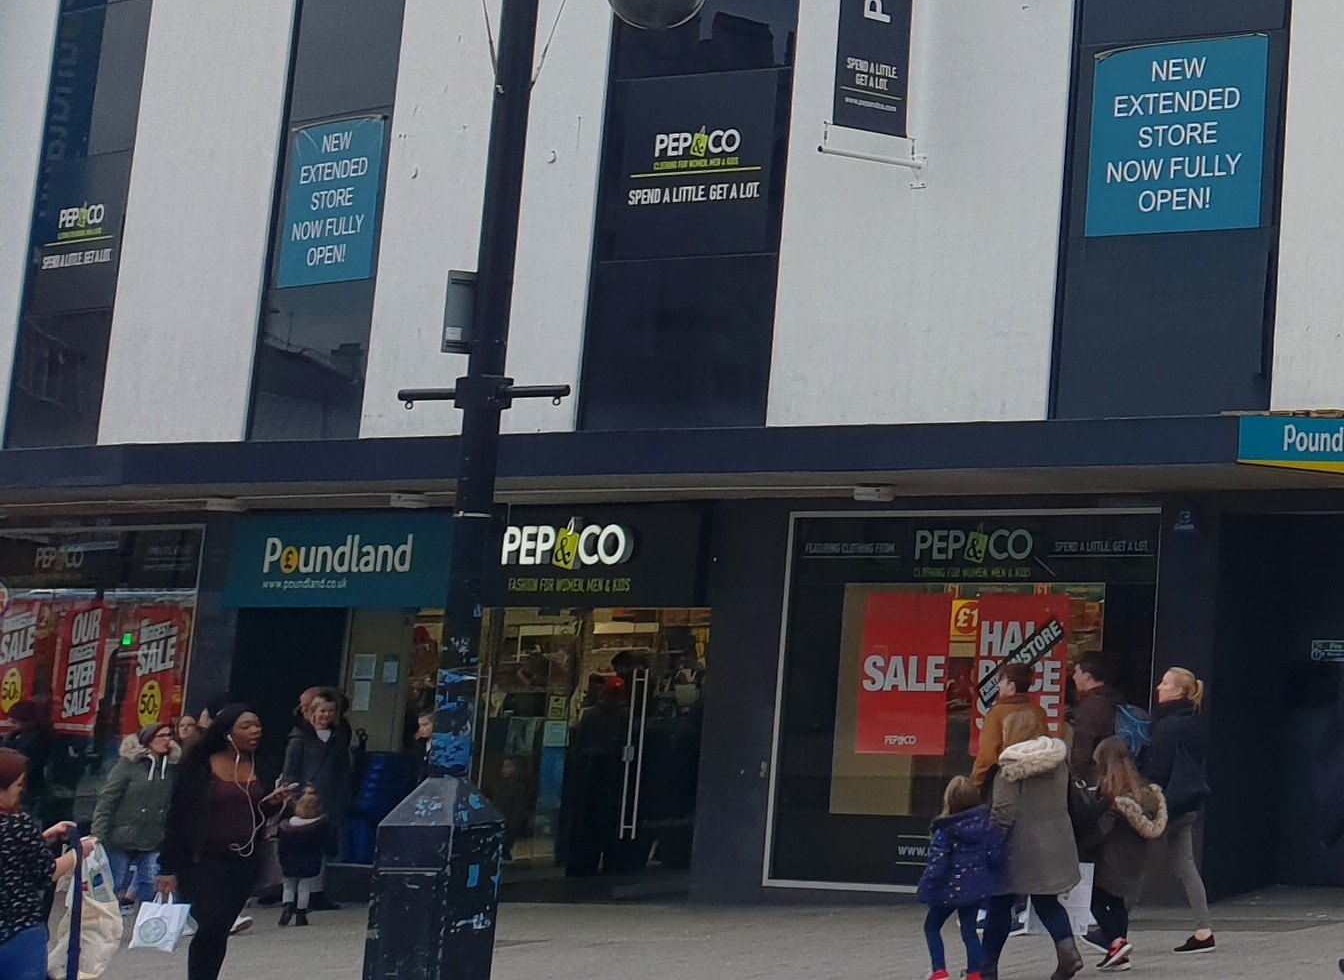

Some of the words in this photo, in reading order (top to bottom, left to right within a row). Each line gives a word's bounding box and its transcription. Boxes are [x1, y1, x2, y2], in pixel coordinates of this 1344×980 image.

[847, 57, 868, 72] SPEND
[1151, 56, 1207, 82] NEW
[855, 73, 868, 86] GET
[1113, 87, 1240, 117] EXTENDED
[322, 131, 352, 153] NEW
[654, 127, 741, 157] PEP&CO
[1138, 122, 1218, 148] STORE
[299, 157, 368, 184] EXTENDED
[1106, 158, 1164, 183] NOW
[1169, 153, 1242, 179] FULLY
[310, 187, 354, 210] STORE
[628, 188, 661, 205] SPEND
[663, 188, 670, 203] A
[709, 184, 729, 200] GET
[730, 183, 738, 199] A
[1138, 187, 1211, 212] OPEN!
[291, 219, 325, 241] NOW
[325, 214, 364, 237] FULLY
[306, 244, 346, 266] OPEN!
[501, 519, 628, 570] PEP&CO
[914, 528, 1033, 563] PEP&CO
[1055, 541, 1078, 552] SPEND
[1079, 541, 1087, 551] A
[1112, 541, 1126, 551] GET
[262, 578, 347, 590] www.poundland.co.uk
[508, 578, 537, 591] FASHION
[539, 578, 553, 591] FOR
[586, 578, 602, 591] MEN
[613, 578, 631, 591] KIDS
[72, 609, 102, 645] OUR
[956, 608, 978, 628] £1
[1, 627, 36, 664] SALE
[136, 634, 178, 677] SALE
[66, 660, 96, 691] EVER
[863, 655, 946, 691] SALE
[62, 687, 93, 719] SALE
